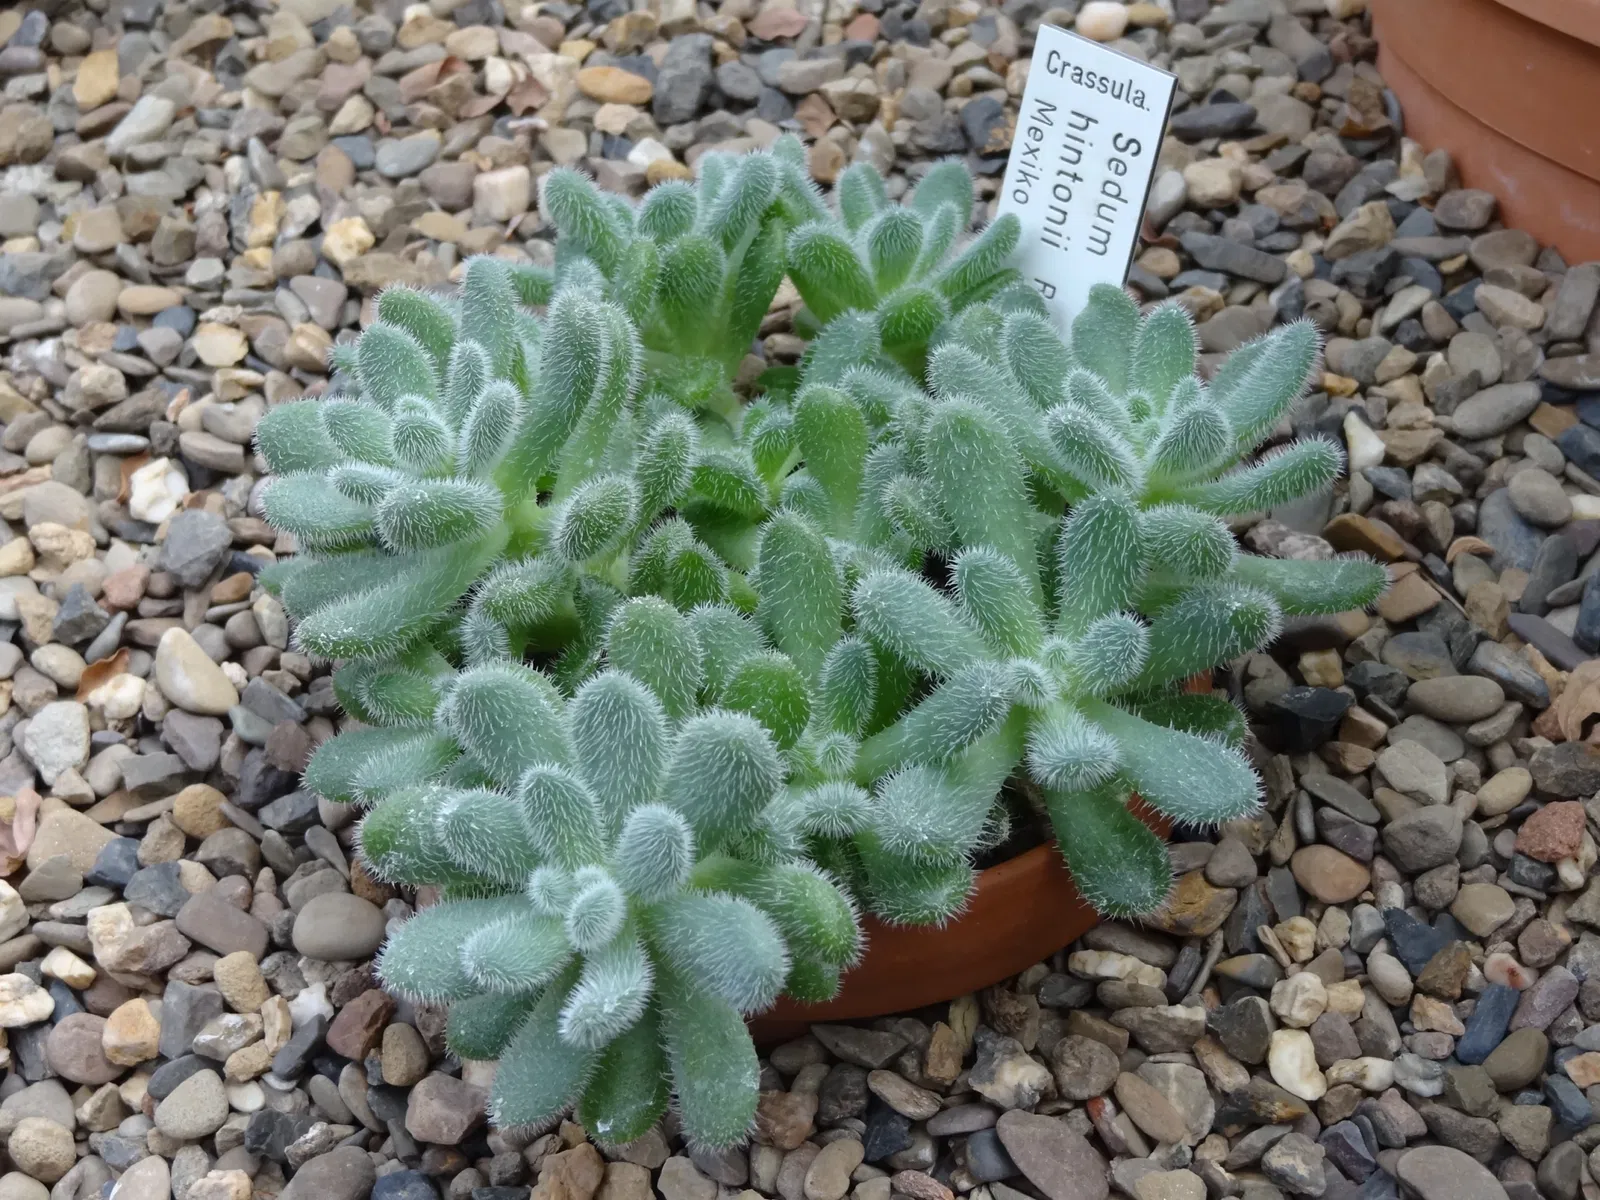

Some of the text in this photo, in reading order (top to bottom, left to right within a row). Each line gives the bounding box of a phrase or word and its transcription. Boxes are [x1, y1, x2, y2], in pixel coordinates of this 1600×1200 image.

[1046, 49, 1150, 112] Crassula.
[1012, 98, 1057, 205] Mexiko
[1040, 109, 1099, 252] hintonii
[1086, 132, 1142, 257] Sedum
